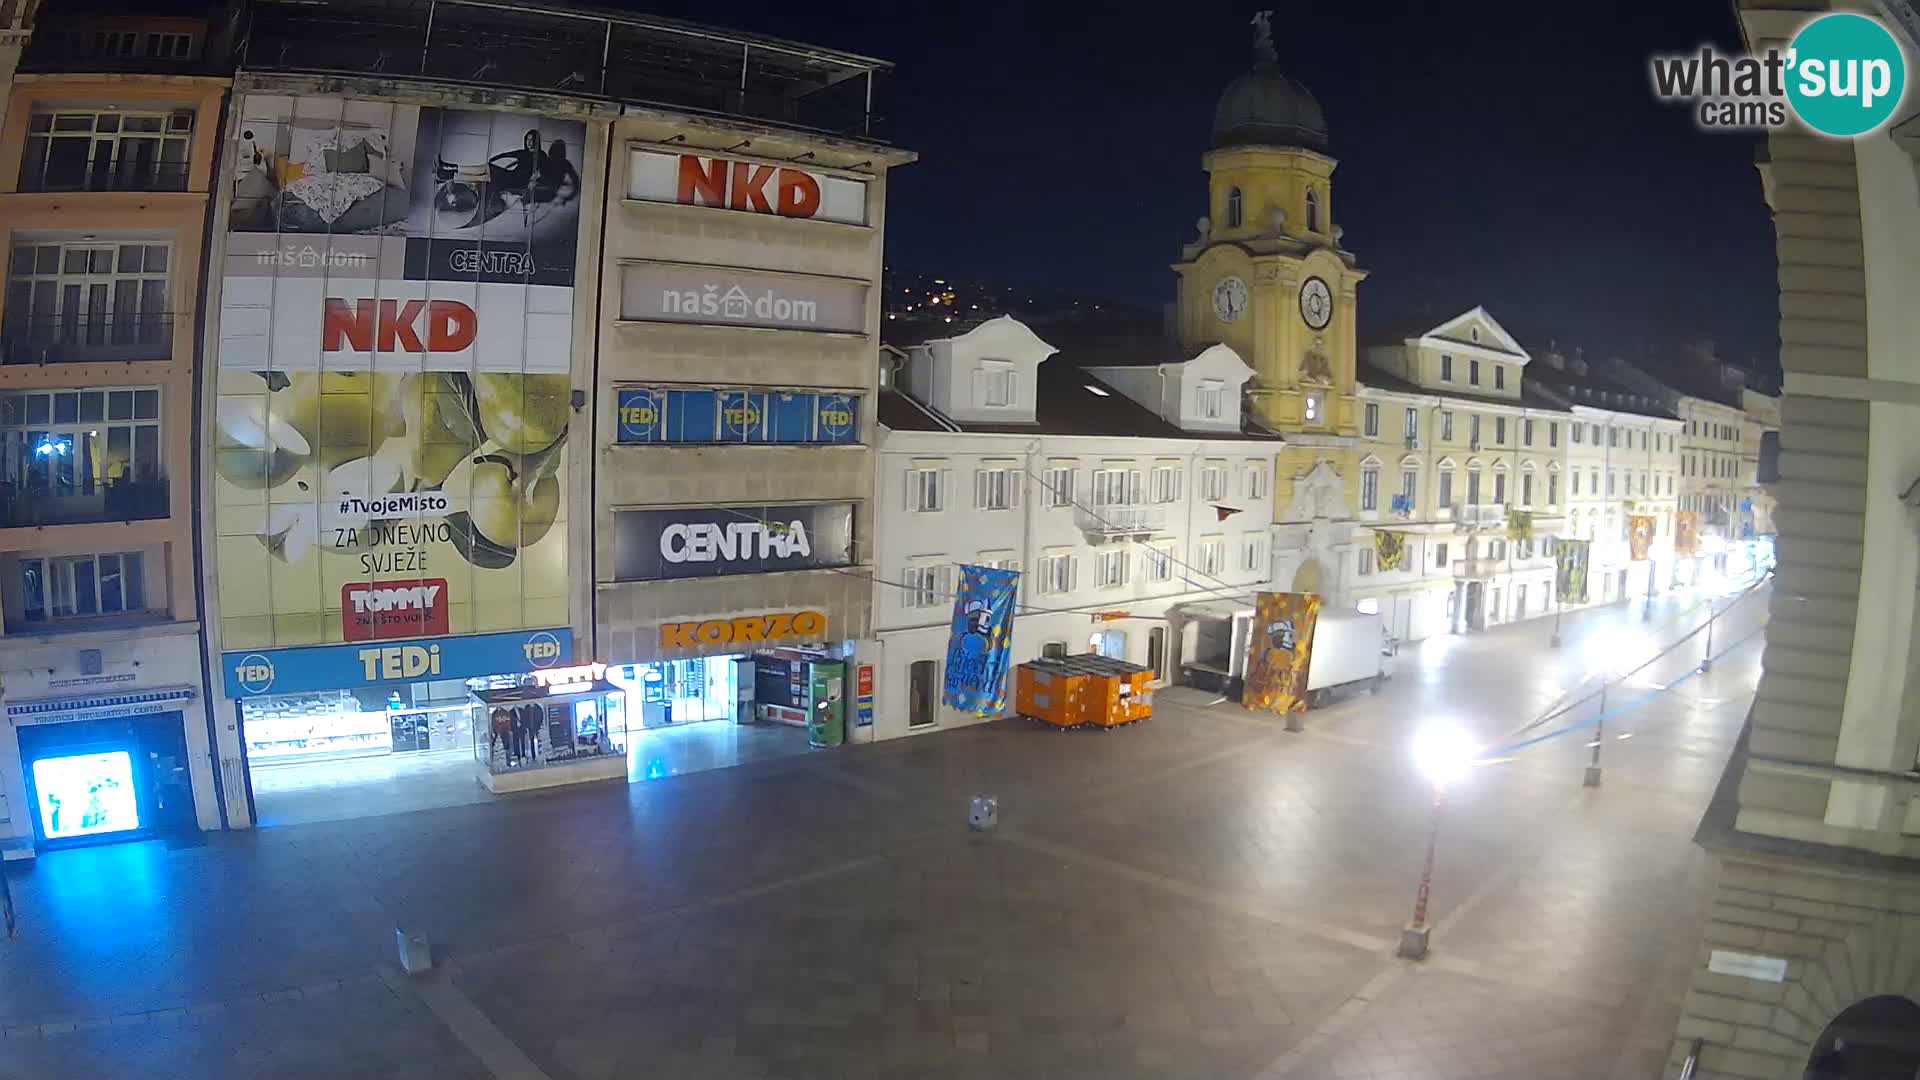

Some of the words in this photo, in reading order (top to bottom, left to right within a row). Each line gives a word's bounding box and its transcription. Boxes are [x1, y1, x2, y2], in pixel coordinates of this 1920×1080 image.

[676, 154, 821, 219] NKD
[257, 244, 298, 267] naš
[322, 248, 367, 268] dom
[450, 249, 535, 275] CENTRA
[662, 284, 719, 316] naš
[754, 289, 817, 323] dom
[322, 298, 478, 352] NKD
[620, 407, 659, 425] TEDi
[724, 408, 760, 426] TEDi
[339, 496, 447, 516] #TvojeMisto
[335, 527, 359, 548] ZA
[367, 522, 452, 547] DNEVNO
[659, 519, 811, 563] CENTRA
[360, 546, 427, 574] SVJEŽE
[350, 585, 440, 613] TOMMY
[661, 611, 828, 649] KORZO
[359, 644, 441, 681] TEDi
[523, 641, 561, 660] TEDi
[235, 664, 275, 684] TEDi
